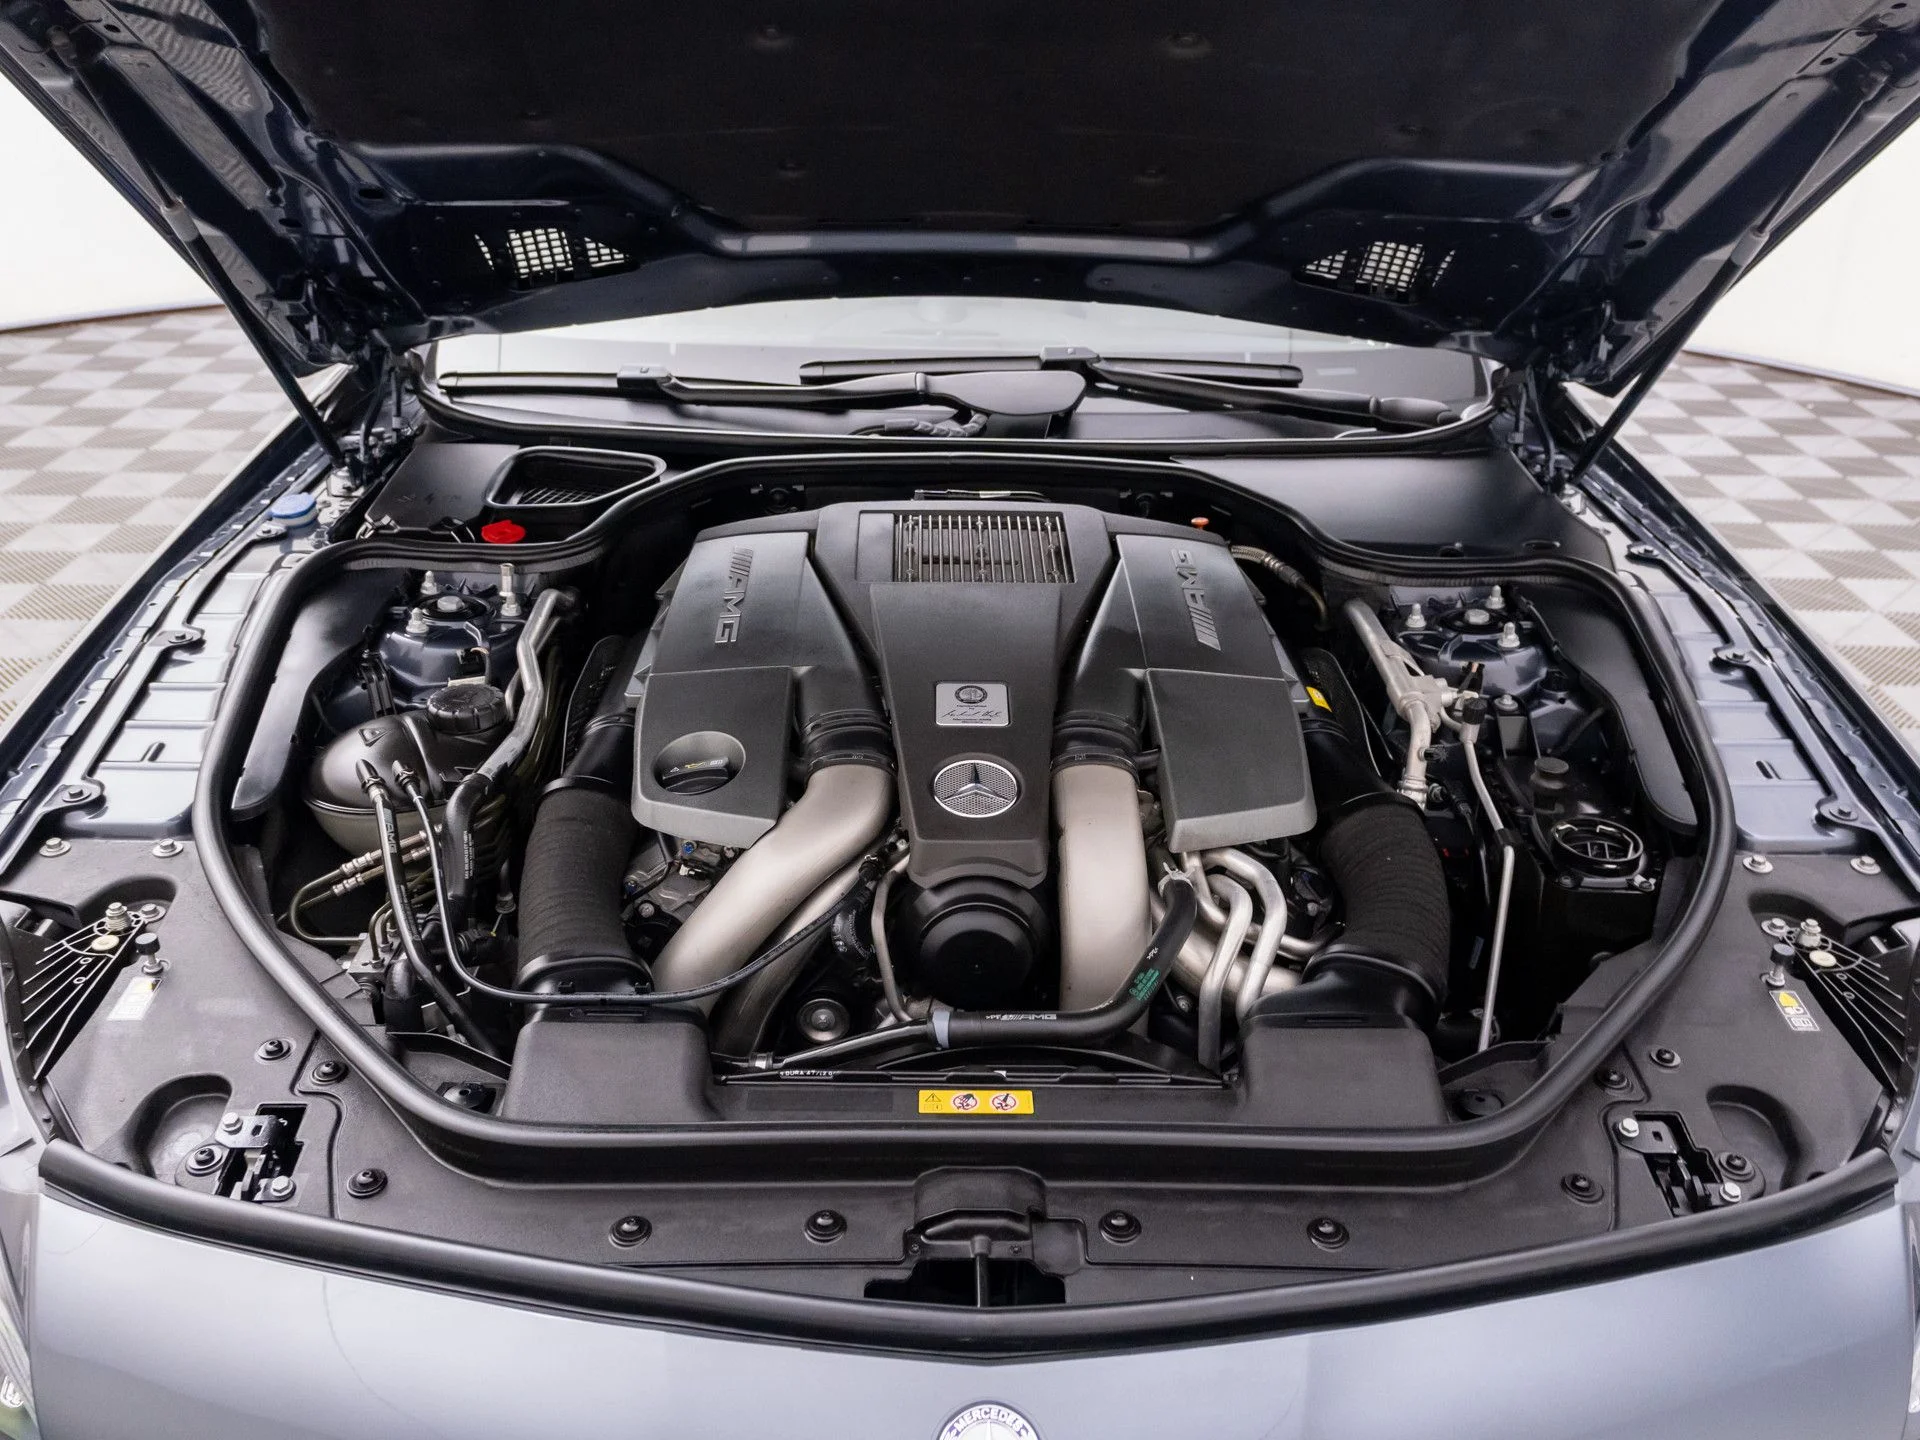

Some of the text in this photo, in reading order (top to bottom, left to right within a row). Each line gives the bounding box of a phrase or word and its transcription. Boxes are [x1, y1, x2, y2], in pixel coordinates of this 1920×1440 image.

[1171, 549, 1212, 615] AMG
[715, 572, 749, 643] AMG
[384, 822, 398, 854] AMG
[953, 1406, 1024, 1432] MERCEDES
